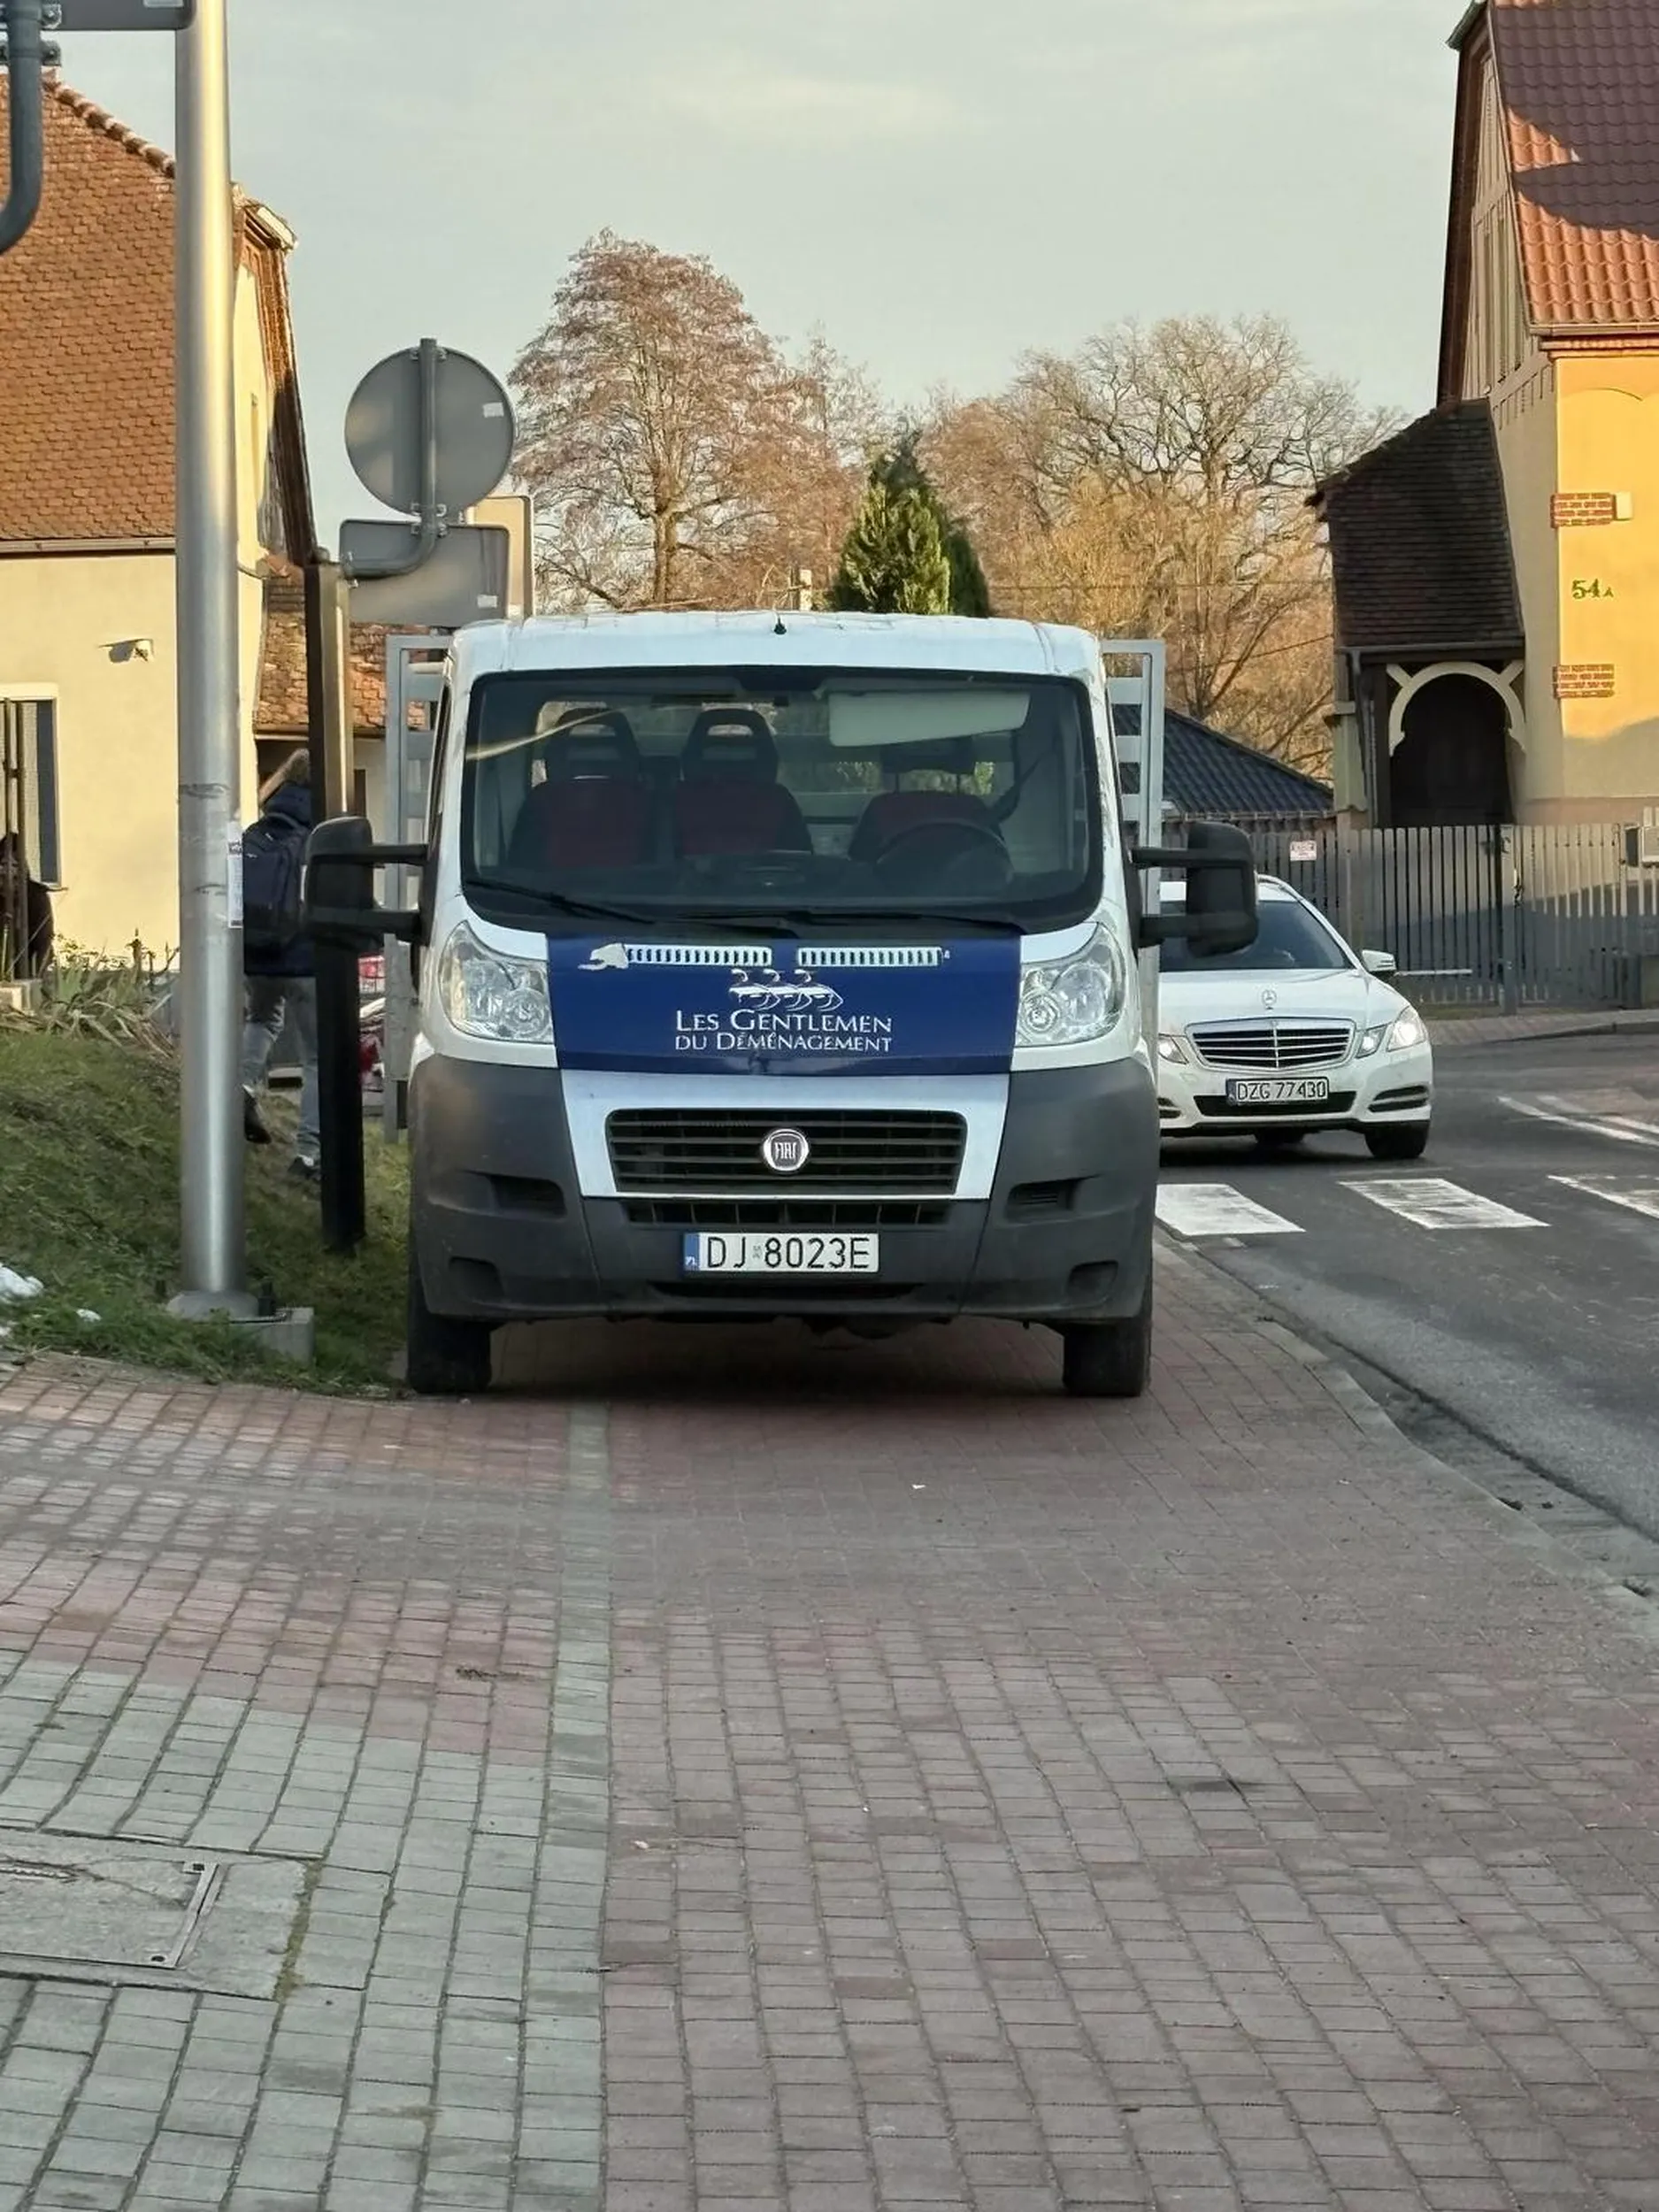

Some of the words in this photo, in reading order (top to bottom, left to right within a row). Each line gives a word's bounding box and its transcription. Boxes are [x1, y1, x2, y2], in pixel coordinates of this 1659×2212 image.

[675, 1034, 707, 1050] DU
[1238, 1082, 1271, 1100] DZG
[1275, 1080, 1326, 1098] 77430
[708, 1237, 746, 1268] DJ
[764, 1237, 870, 1268] 8023E
